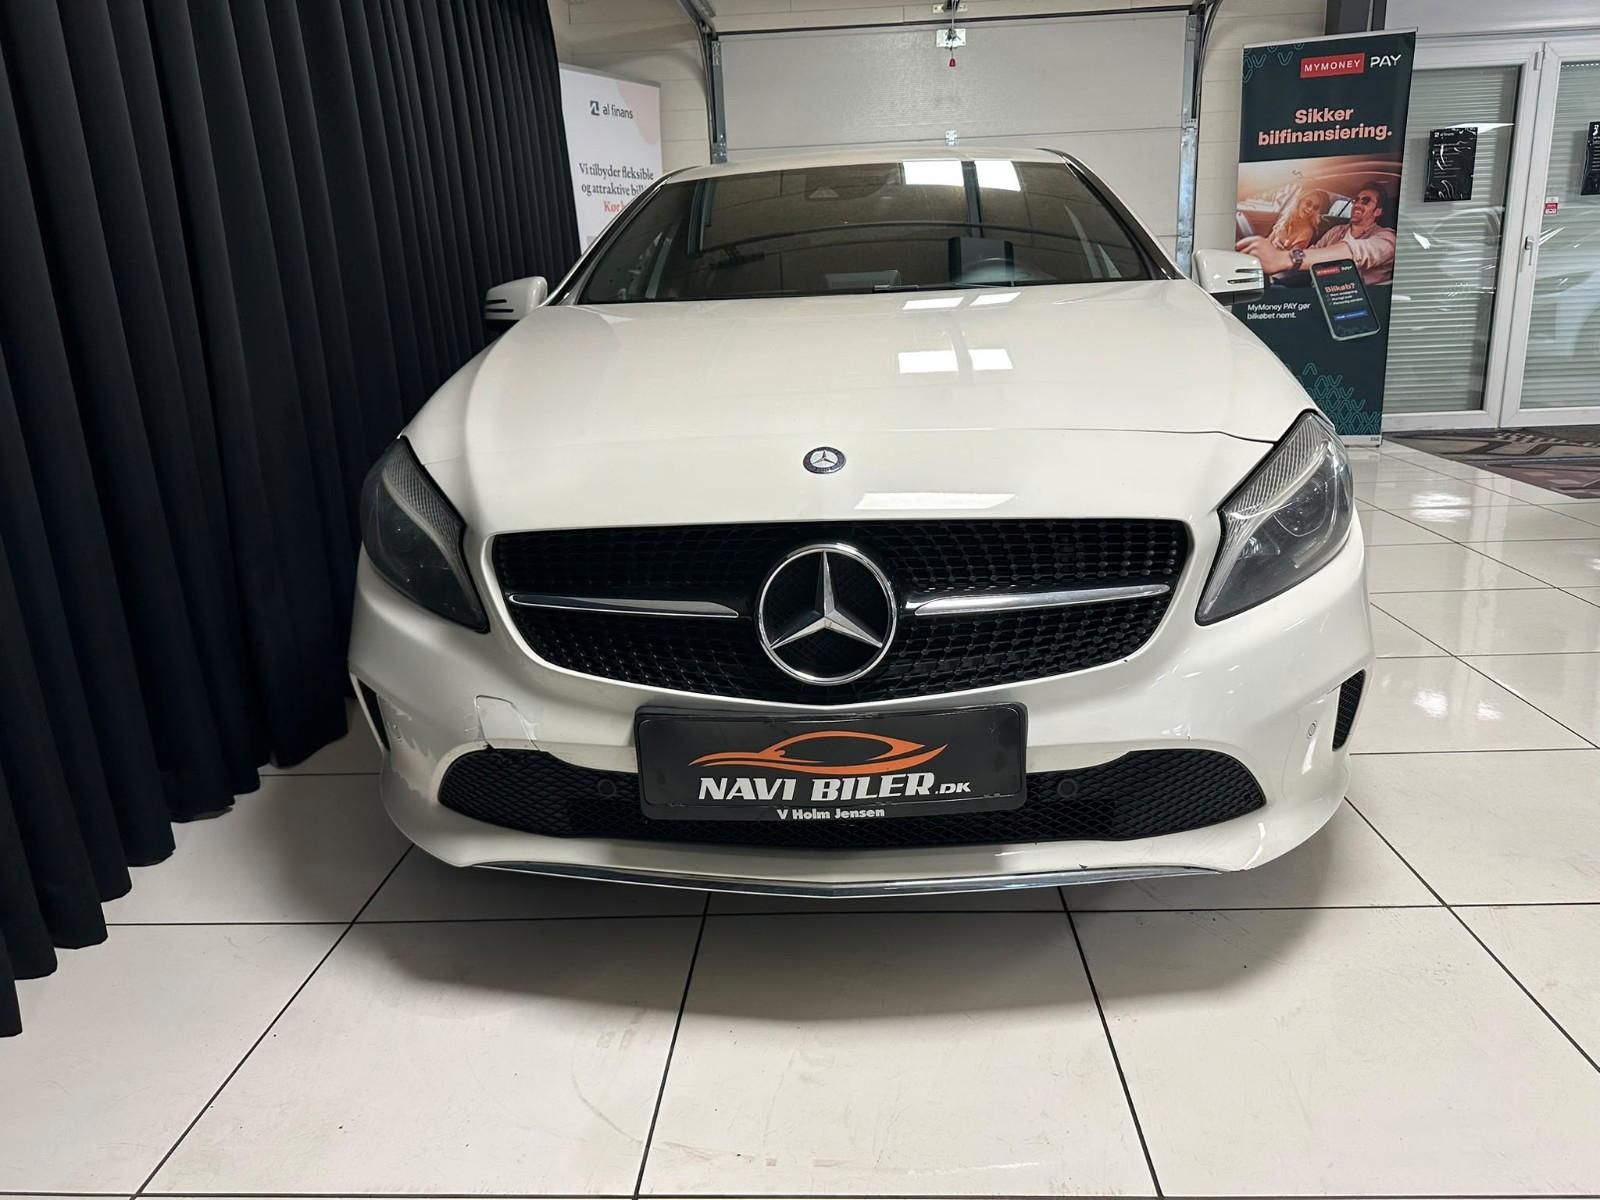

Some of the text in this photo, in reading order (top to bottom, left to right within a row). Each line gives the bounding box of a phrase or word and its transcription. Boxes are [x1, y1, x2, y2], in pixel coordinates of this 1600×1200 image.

[1304, 54, 1401, 72] MYMONEY PAY
[602, 104, 634, 119] al finans
[1295, 107, 1354, 124] Sikker
[1258, 123, 1393, 146] bilfinansiering.
[579, 162, 654, 180] Vi tilbyder fleksible
[581, 183, 592, 197] og
[592, 183, 630, 196] attraktive
[1247, 303, 1282, 312] MyMoney
[1283, 302, 1298, 310] PAY
[698, 777, 797, 801] NAVI
[777, 807, 885, 820] V Holm Jensen
